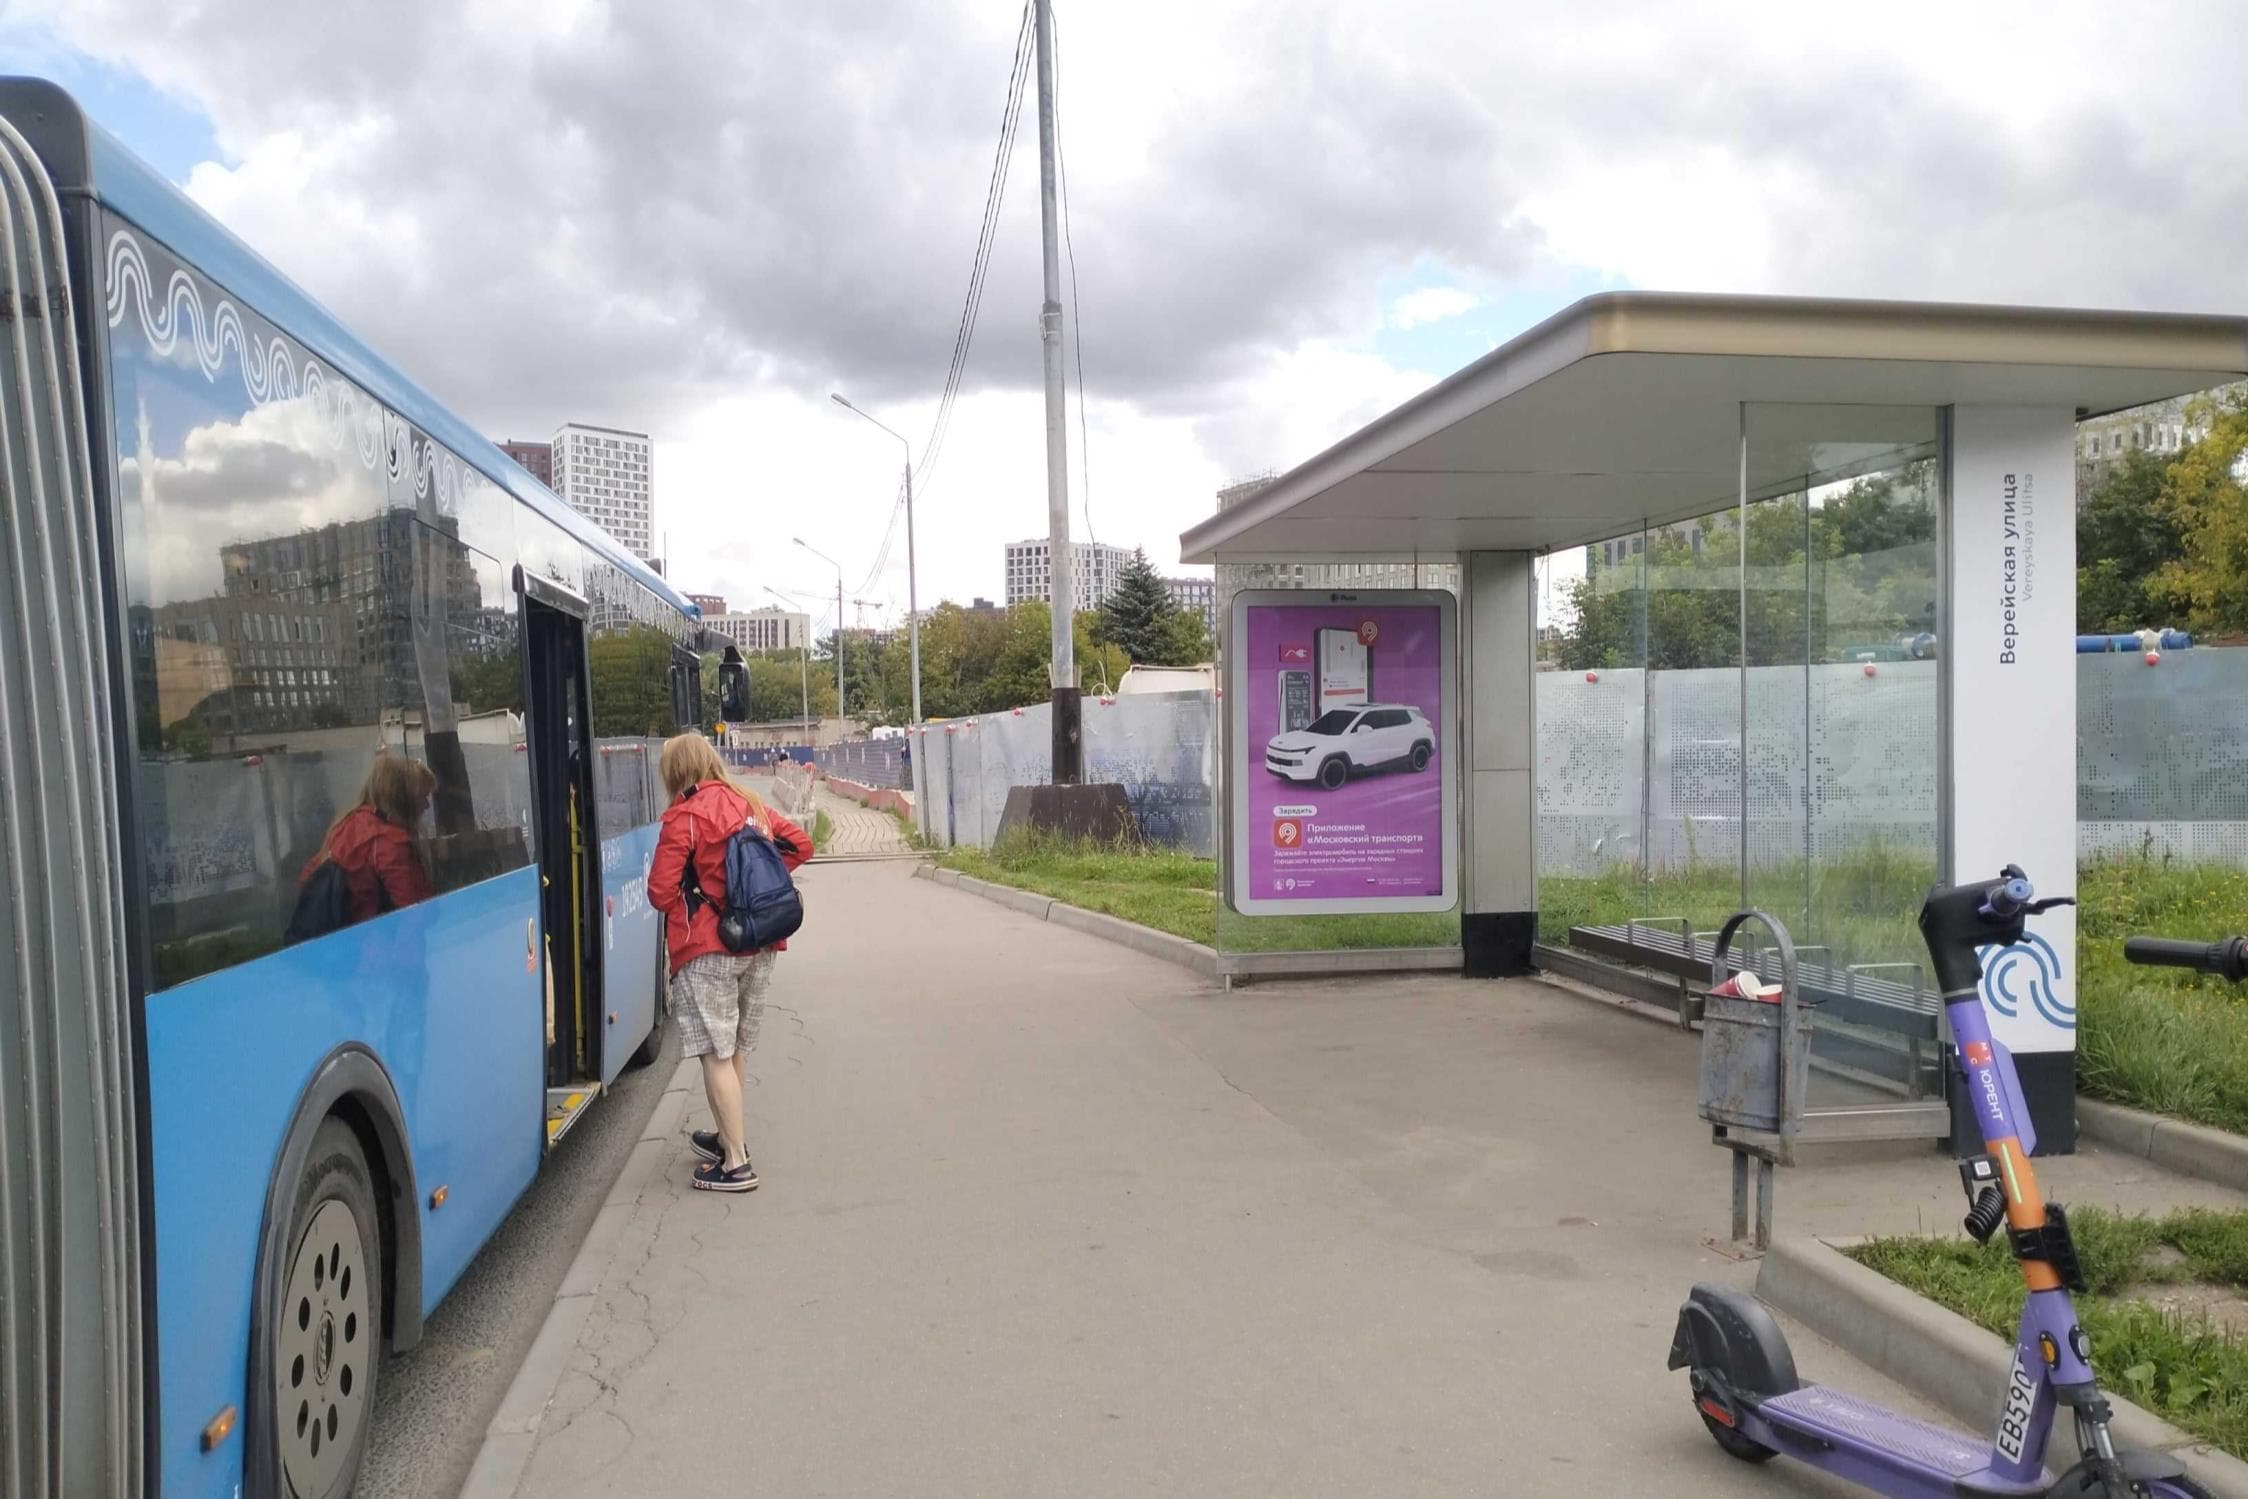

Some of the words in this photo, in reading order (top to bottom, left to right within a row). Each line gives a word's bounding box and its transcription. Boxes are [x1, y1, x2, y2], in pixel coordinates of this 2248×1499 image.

[2003, 473, 2020, 540] улица
[2022, 473, 2034, 517] Ulitsa
[2022, 520, 2035, 602] Vereyskaya
[1999, 545, 2020, 665] Верейская
[1278, 806, 1313, 816] Зарядить
[1307, 823, 1366, 834] Приложение
[1307, 834, 1370, 844] «Московский
[1371, 834, 1424, 845] транспорт»
[1980, 1068, 2004, 1120] ЮРЕНТ
[1999, 1354, 2033, 1458] EB590
